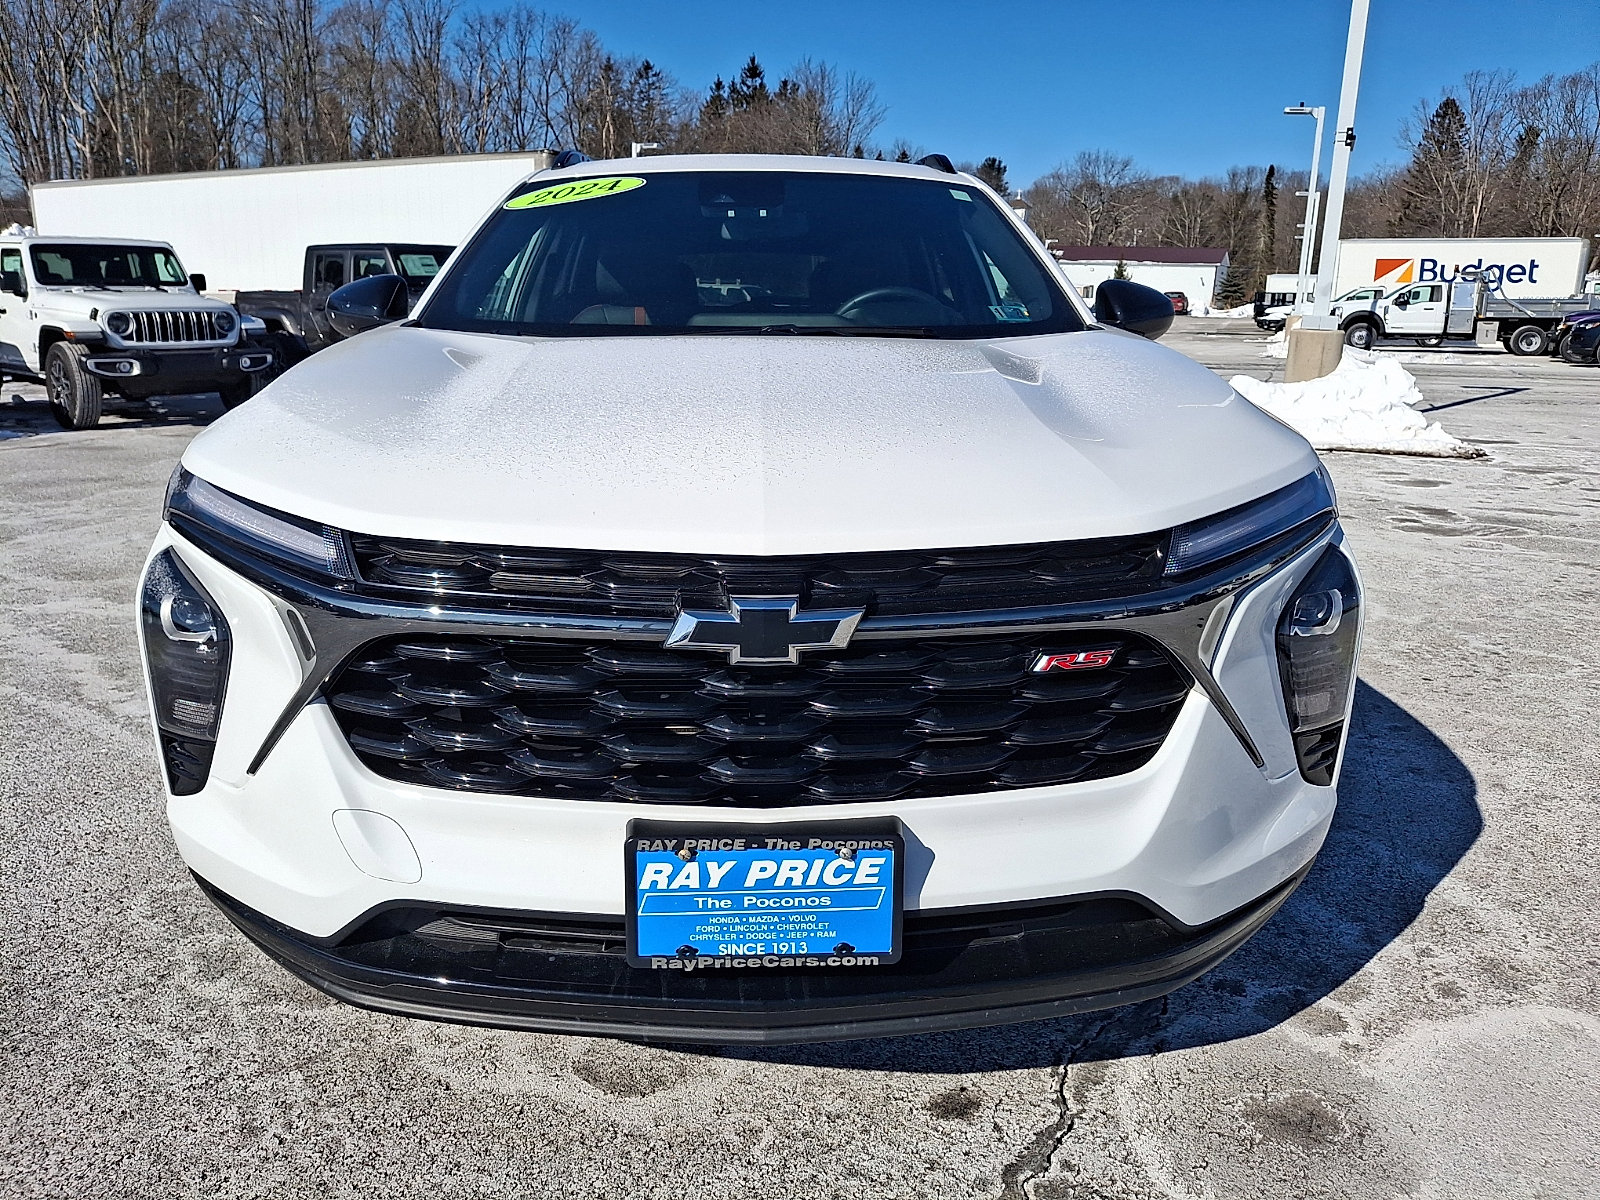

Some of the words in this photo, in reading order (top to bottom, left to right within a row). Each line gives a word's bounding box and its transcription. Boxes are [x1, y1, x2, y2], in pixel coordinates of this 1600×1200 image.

[526, 179, 623, 206] 2024
[1419, 258, 1540, 292] Budget
[1035, 649, 1117, 672] RS
[637, 840, 677, 850] RAY
[684, 839, 746, 850] PRICE
[765, 839, 800, 850] The
[808, 839, 893, 849] Poconos
[639, 860, 738, 889] RAY
[744, 858, 886, 887] PRICE
[694, 897, 732, 909] The
[743, 896, 831, 907] Poconos
[719, 943, 765, 955] SINCE
[772, 942, 808, 954] 1913
[652, 955, 879, 971] RayPriceCars.com
